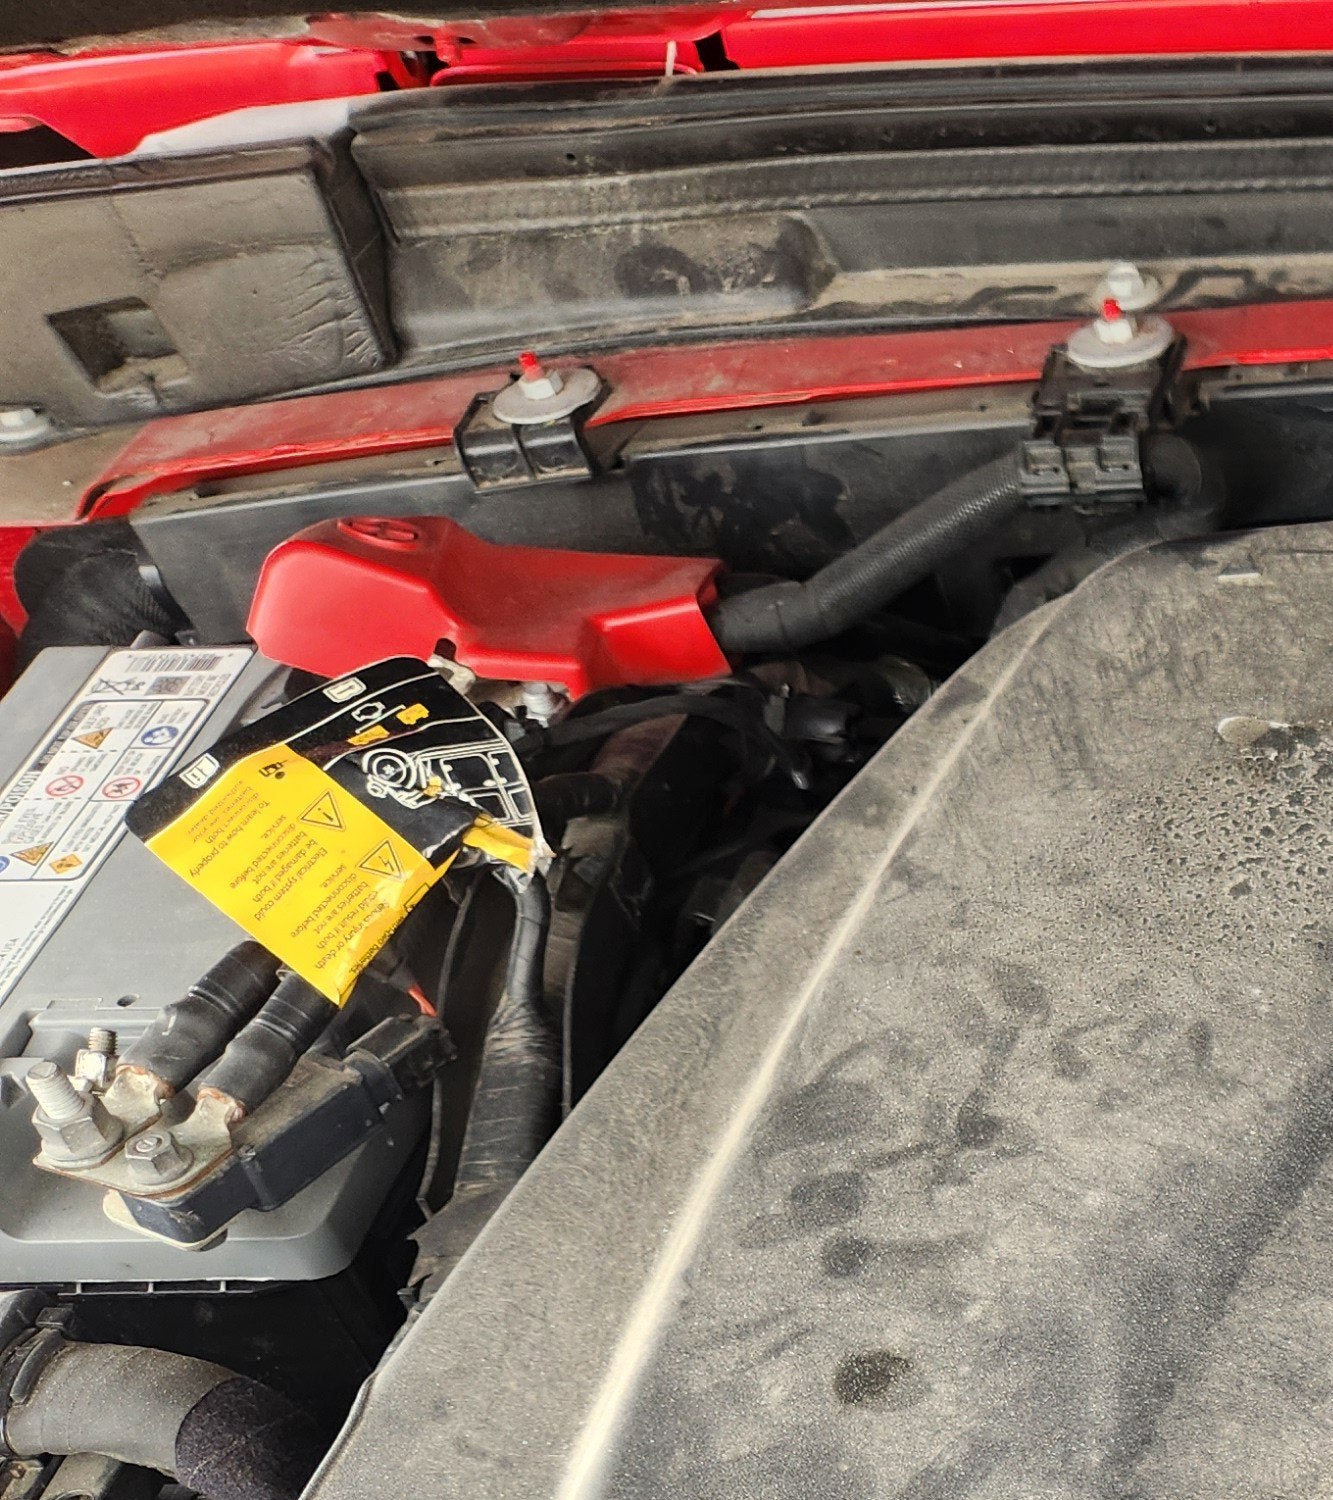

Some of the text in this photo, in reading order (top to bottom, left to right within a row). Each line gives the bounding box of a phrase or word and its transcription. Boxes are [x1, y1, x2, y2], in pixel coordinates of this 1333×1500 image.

[188, 800, 268, 877] To learn how to properly
[205, 827, 223, 844] both
[306, 840, 316, 850] be
[230, 824, 296, 888] disconnected before
[252, 831, 305, 883] batteries are not
[274, 849, 306, 880] damaged
[253, 885, 270, 902] both
[254, 848, 326, 920] Electrical system could
[290, 873, 356, 937] disconnected before
[313, 881, 367, 933] batteries are not
[317, 932, 334, 949] both
[335, 941, 344, 949] or
[315, 949, 337, 969] death
